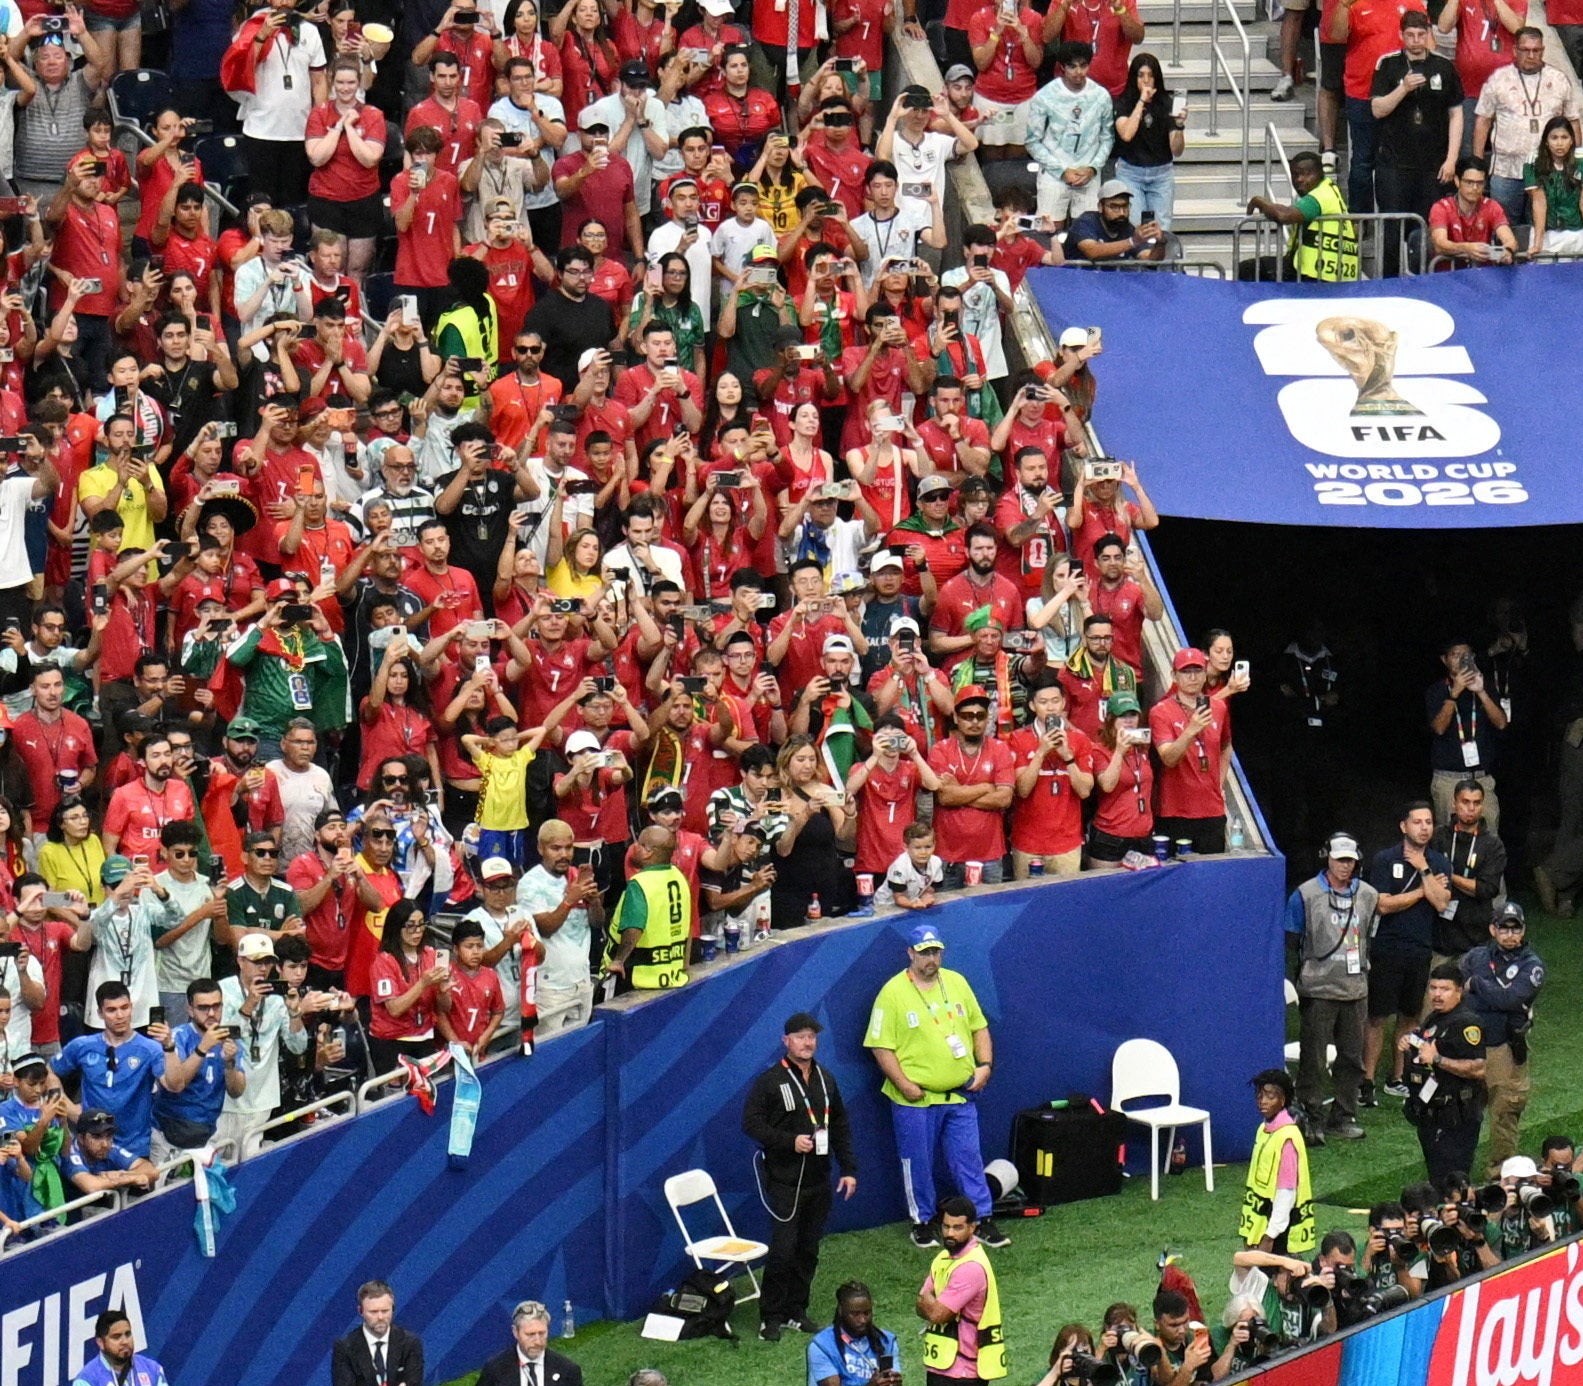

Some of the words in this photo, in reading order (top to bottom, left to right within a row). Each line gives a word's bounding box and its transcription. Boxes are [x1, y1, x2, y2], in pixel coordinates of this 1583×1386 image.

[862, 21, 871, 40] 7
[1092, 20, 1100, 41] 7
[1481, 20, 1489, 41] 7
[450, 142, 461, 165] 7
[1066, 133, 1080, 153] 7
[830, 177, 841, 199] 7
[426, 212, 436, 235] 7
[195, 257, 207, 278] 7
[660, 403, 669, 425] 7
[1350, 423, 1447, 445] FIFA
[1305, 462, 1440, 482] WORLD
[1444, 462, 1518, 481] CUP
[1317, 481, 1529, 507] 2026
[717, 565, 727, 582] 7
[550, 670, 561, 692] 7
[589, 813, 598, 829] 7
[887, 801, 896, 823] 7
[467, 1007, 478, 1032] 7
[205, 1066, 214, 1084] 4
